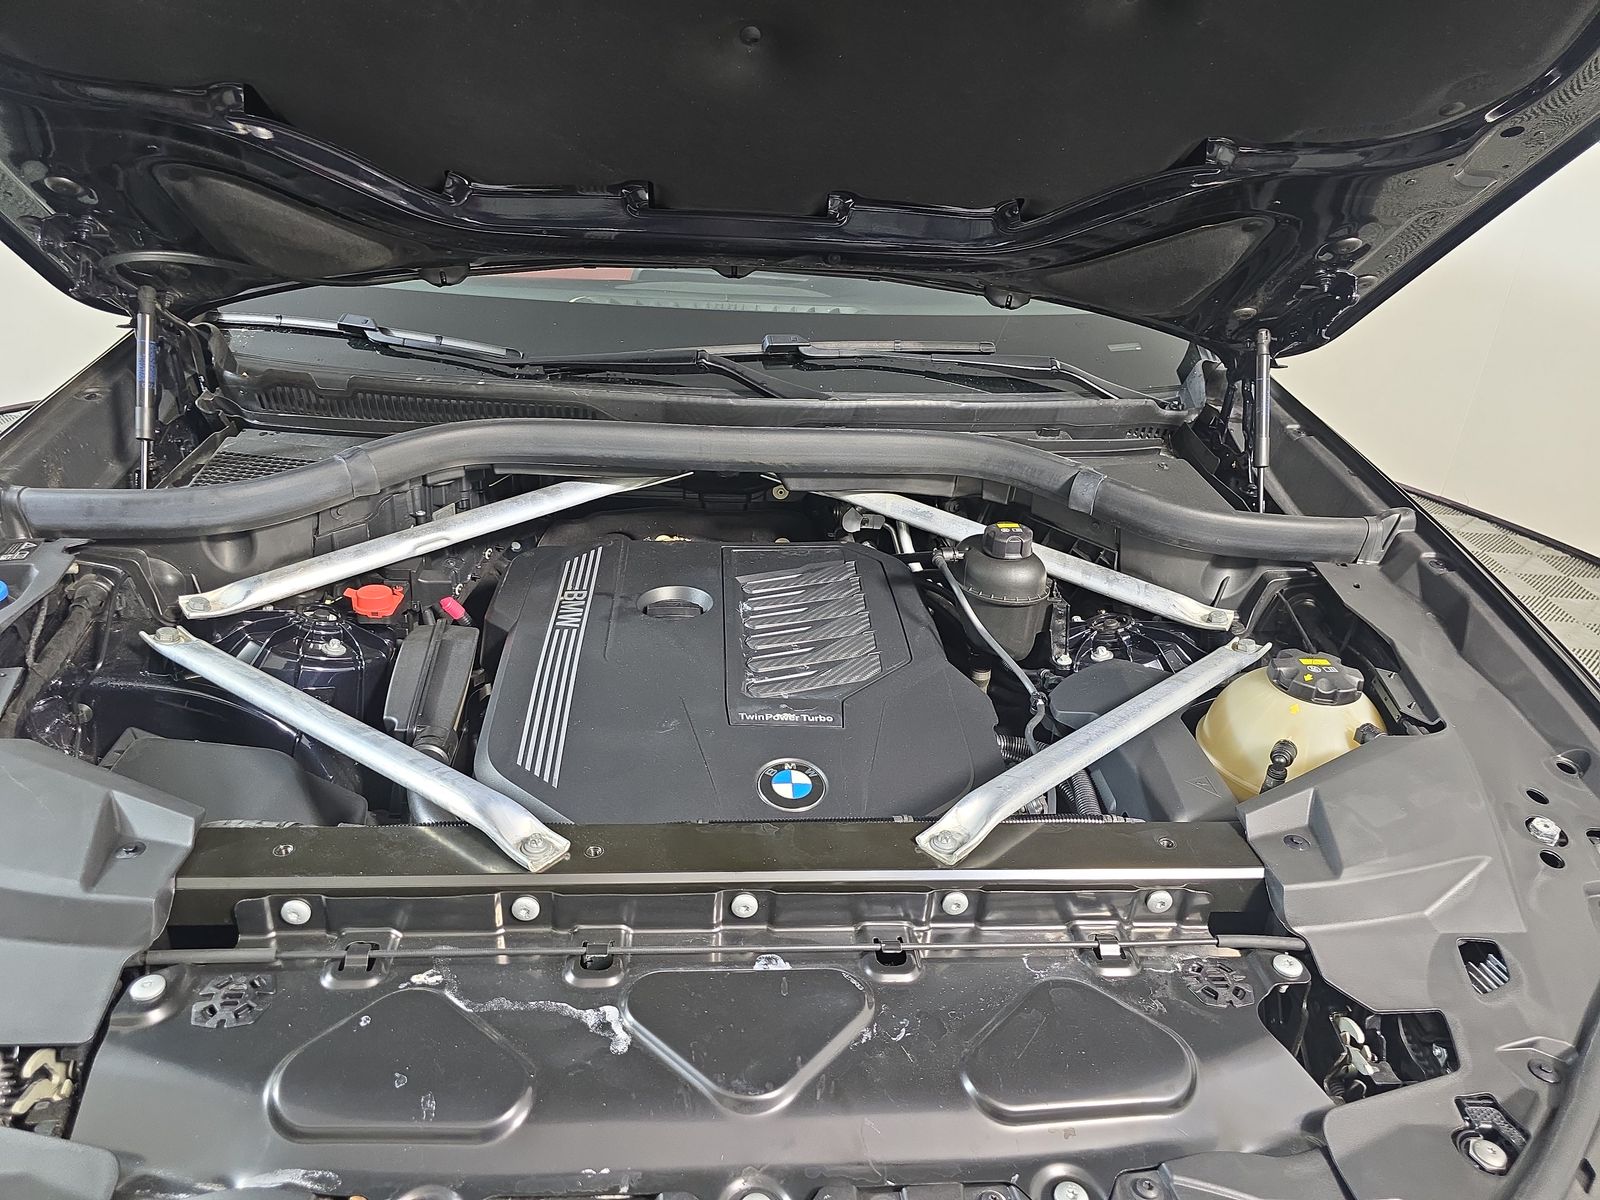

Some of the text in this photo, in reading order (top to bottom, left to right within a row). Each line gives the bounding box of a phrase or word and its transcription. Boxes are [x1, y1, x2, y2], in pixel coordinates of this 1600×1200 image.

[555, 590, 588, 628] BMW
[800, 714, 834, 722] Turbo
[765, 763, 818, 778] BMW
